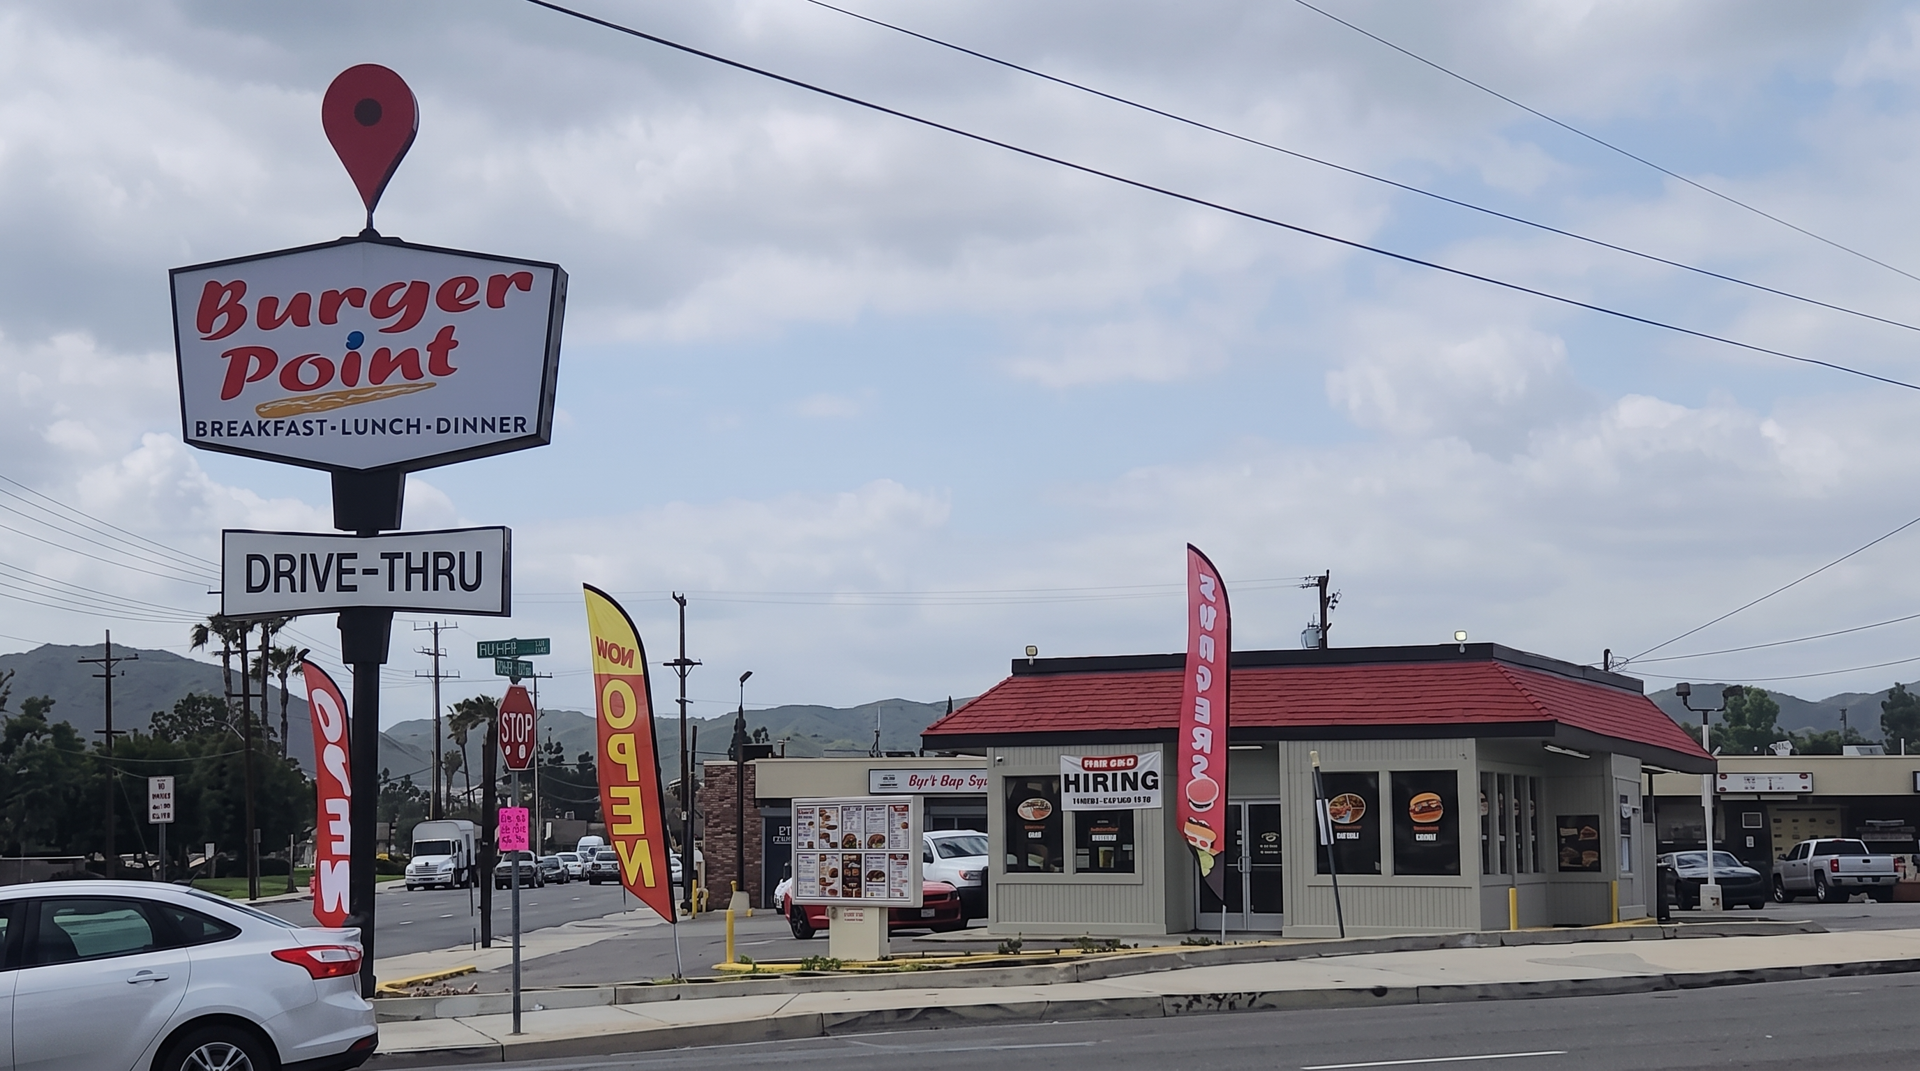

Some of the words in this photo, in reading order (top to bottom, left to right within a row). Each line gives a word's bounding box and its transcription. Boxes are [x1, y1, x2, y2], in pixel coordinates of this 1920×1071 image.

[196, 271, 534, 341] Burger
[220, 325, 459, 400] Point
[246, 551, 482, 593] DRIVE-THRU
[501, 712, 533, 743] STOP
[1063, 770, 1159, 793] HIRING
